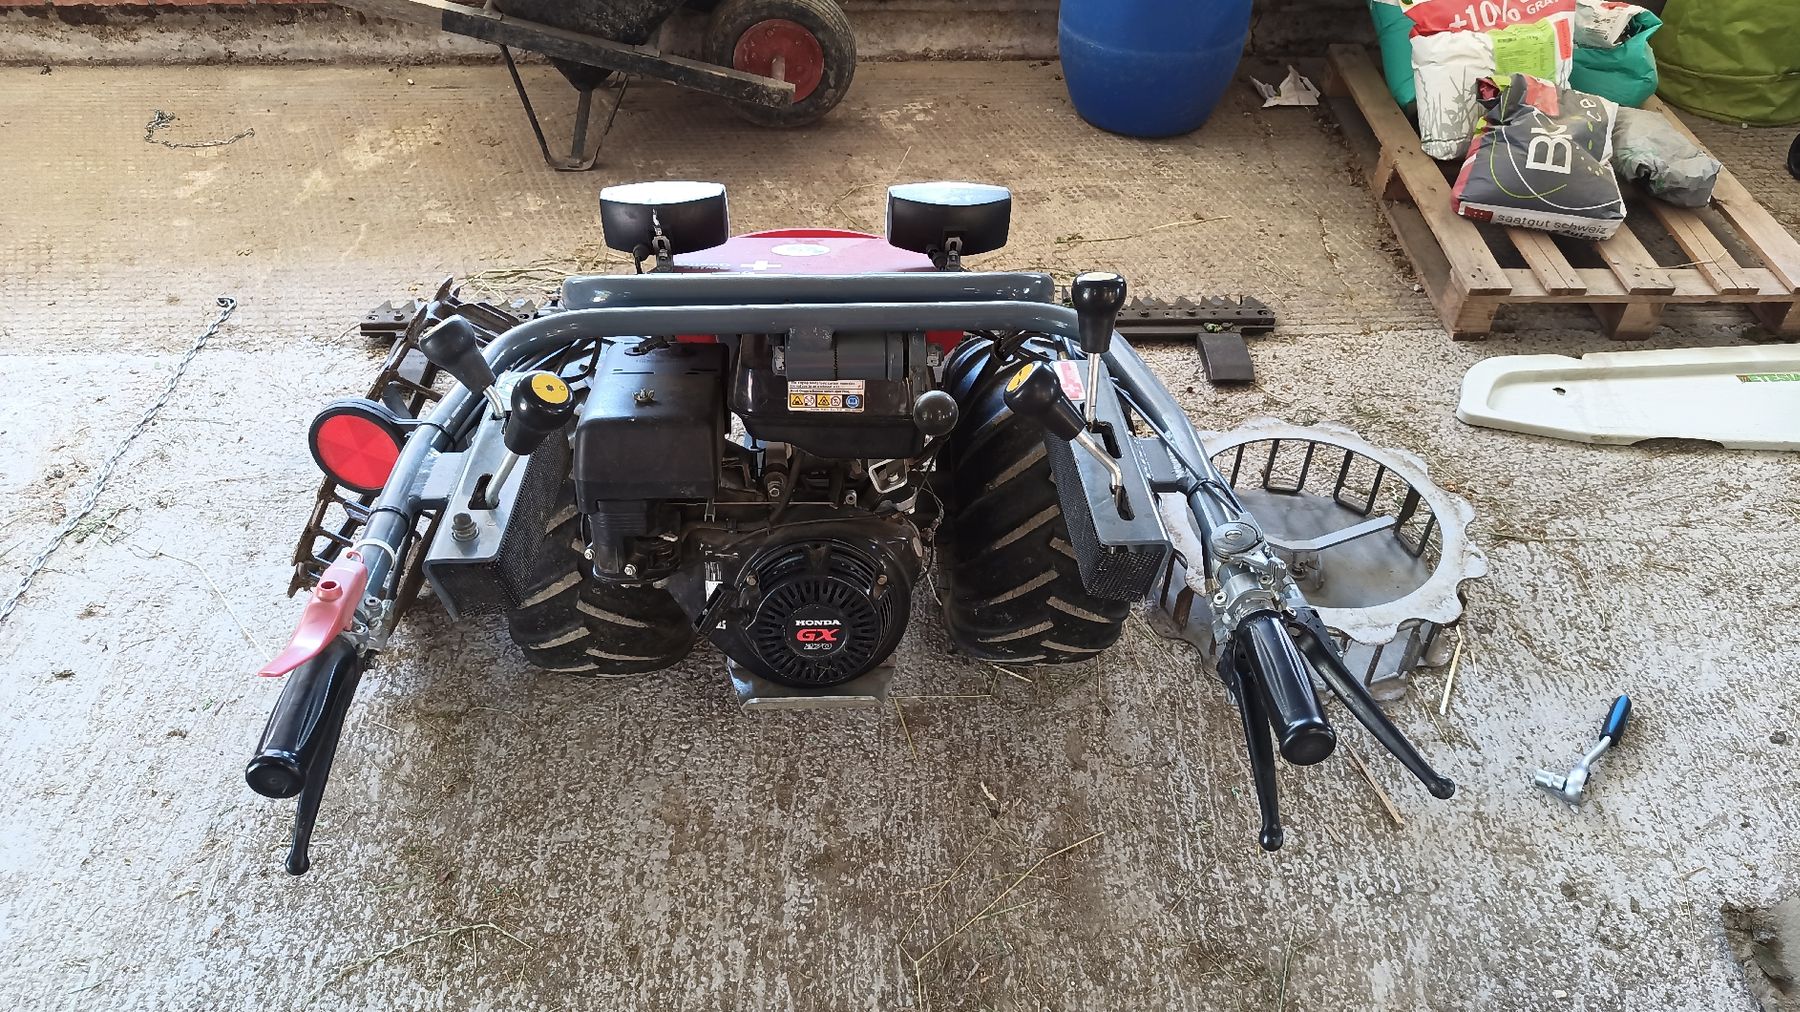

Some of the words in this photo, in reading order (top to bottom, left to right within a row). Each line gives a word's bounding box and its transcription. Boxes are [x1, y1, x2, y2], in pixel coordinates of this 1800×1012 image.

[1497, 214, 1550, 228] saatgut
[1553, 221, 1609, 235] schweiz
[796, 628, 840, 641] GX
